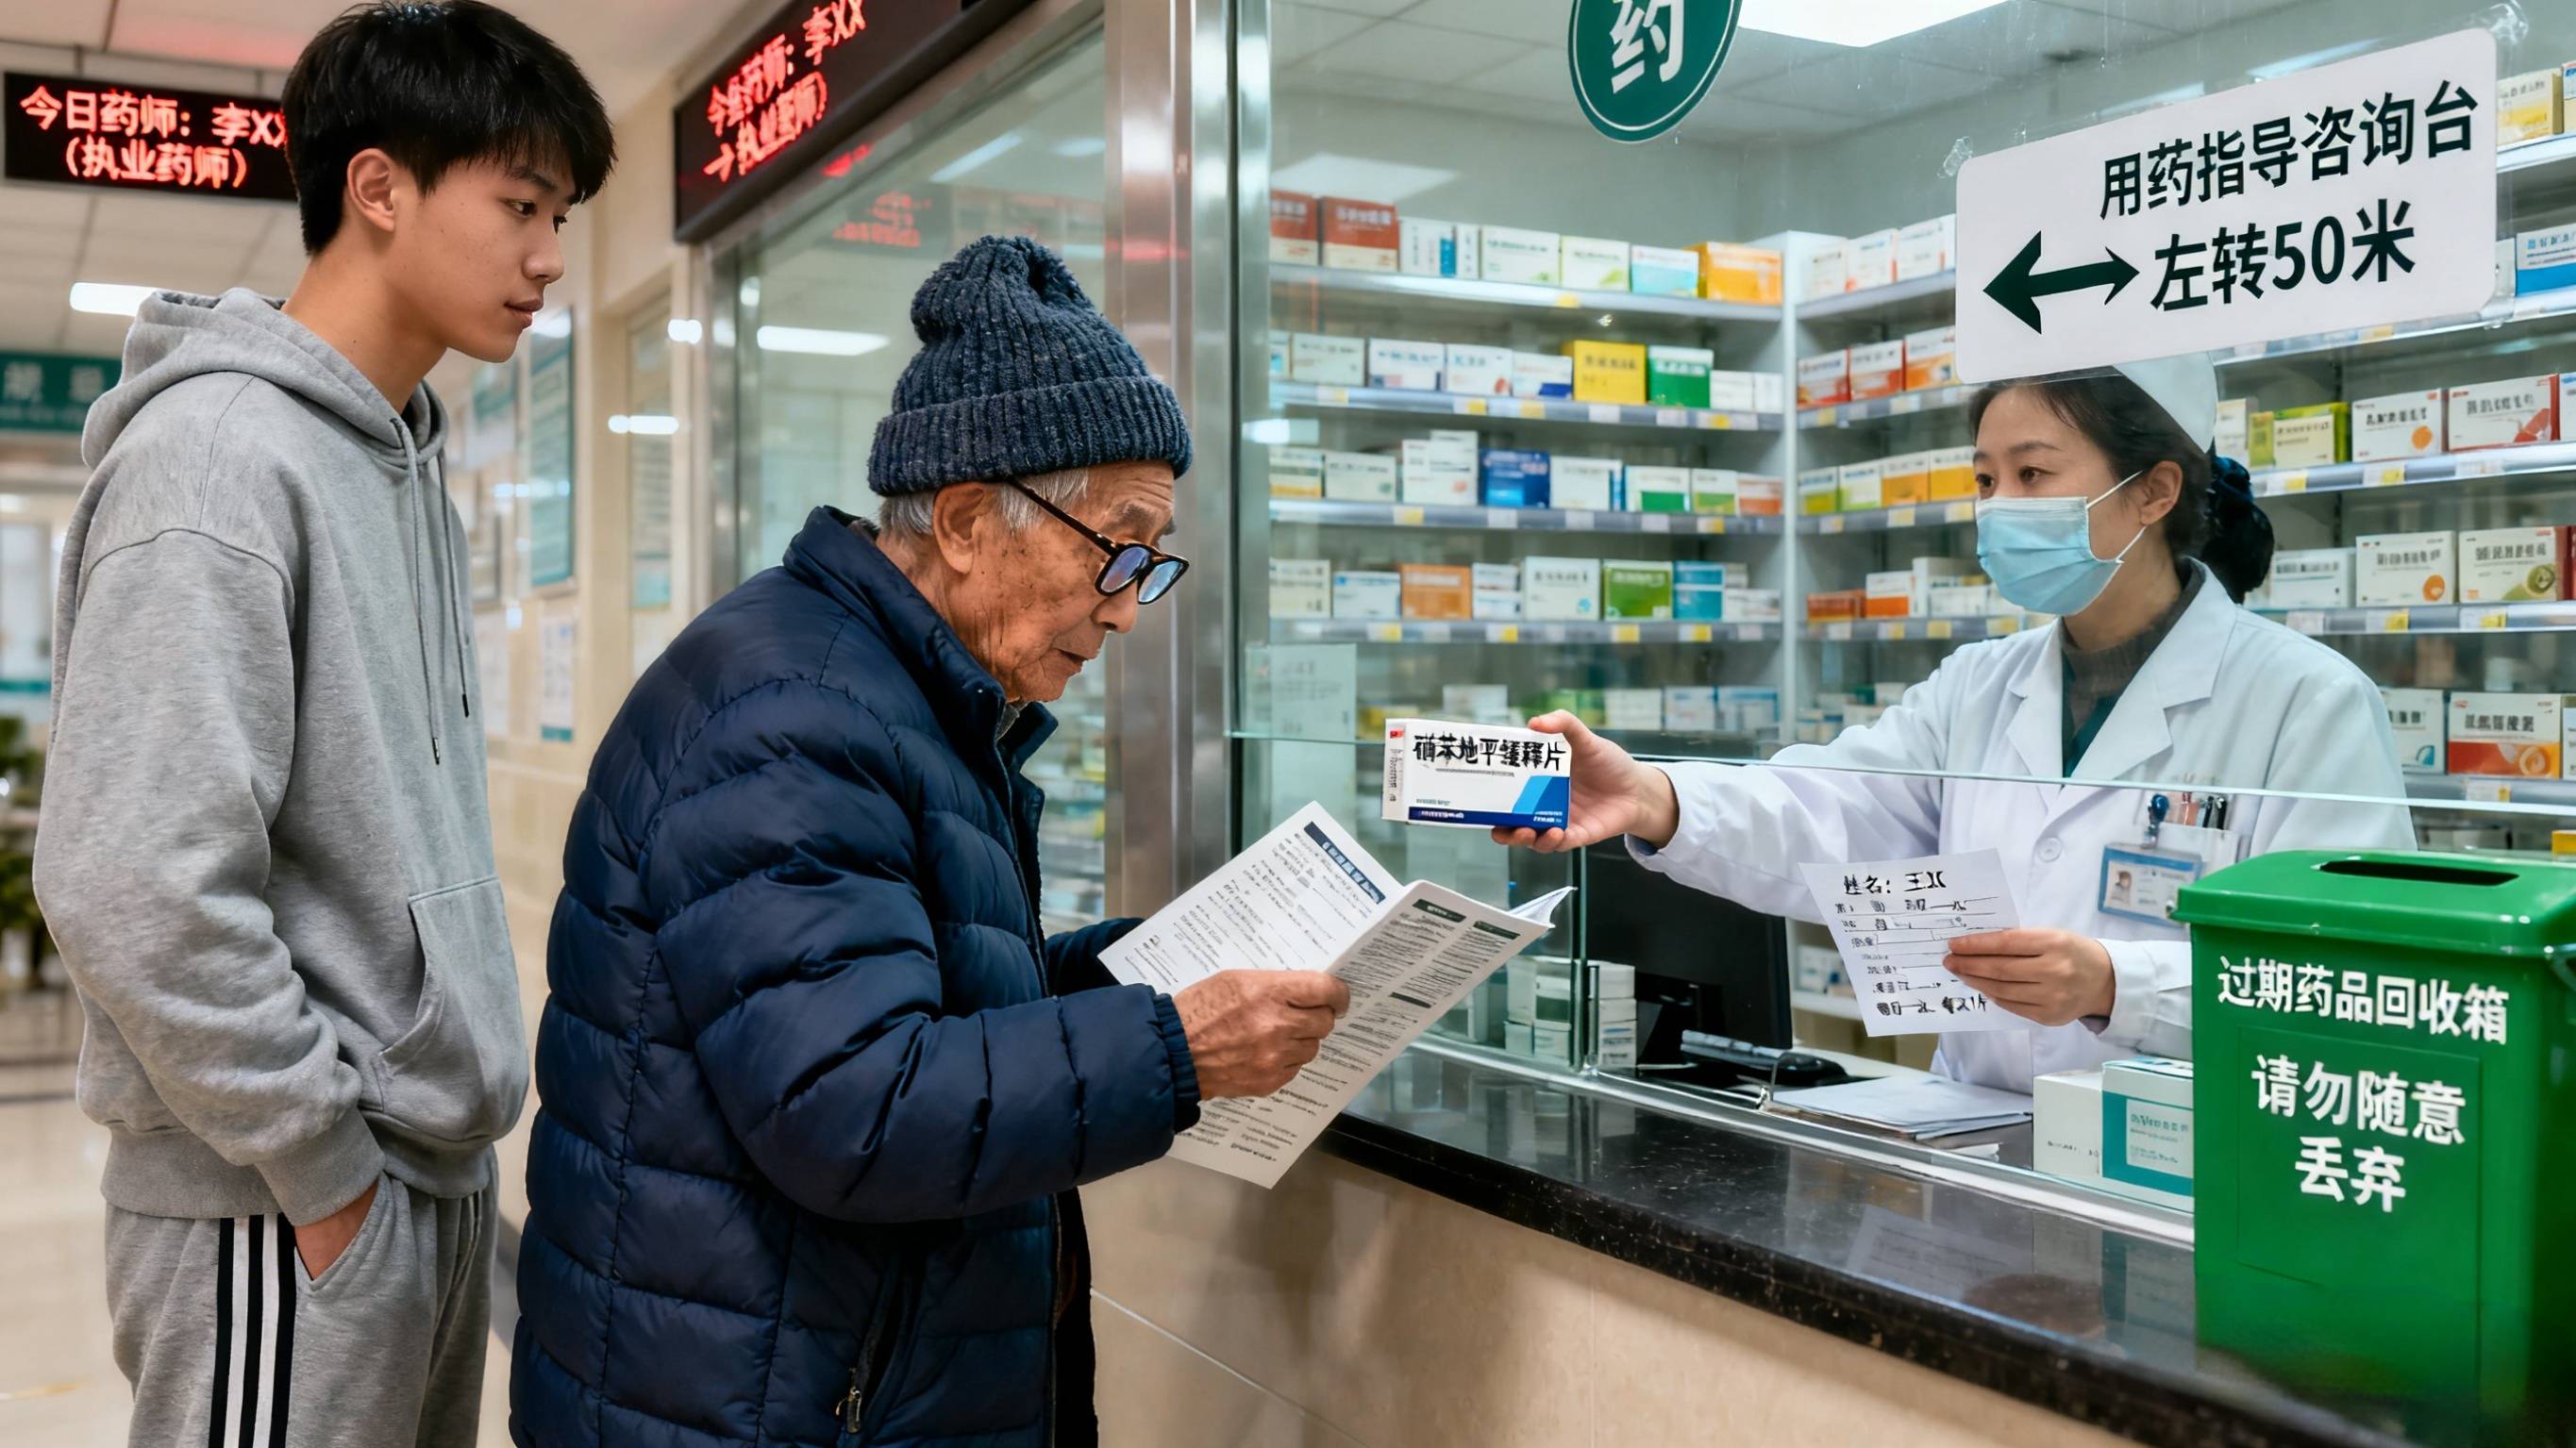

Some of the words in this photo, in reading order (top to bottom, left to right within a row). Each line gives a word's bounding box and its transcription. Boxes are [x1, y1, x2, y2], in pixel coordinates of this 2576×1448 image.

[66, 135, 247, 189] (执业药师)
[2100, 80, 2479, 221] 用药指导咨询台
[2150, 198, 2416, 312] 左转50米
[2217, 956, 2510, 1045] 过期药品回收箱
[2251, 1055, 2466, 1145] 请勿随意
[2295, 1136, 2406, 1213] 丢弃
